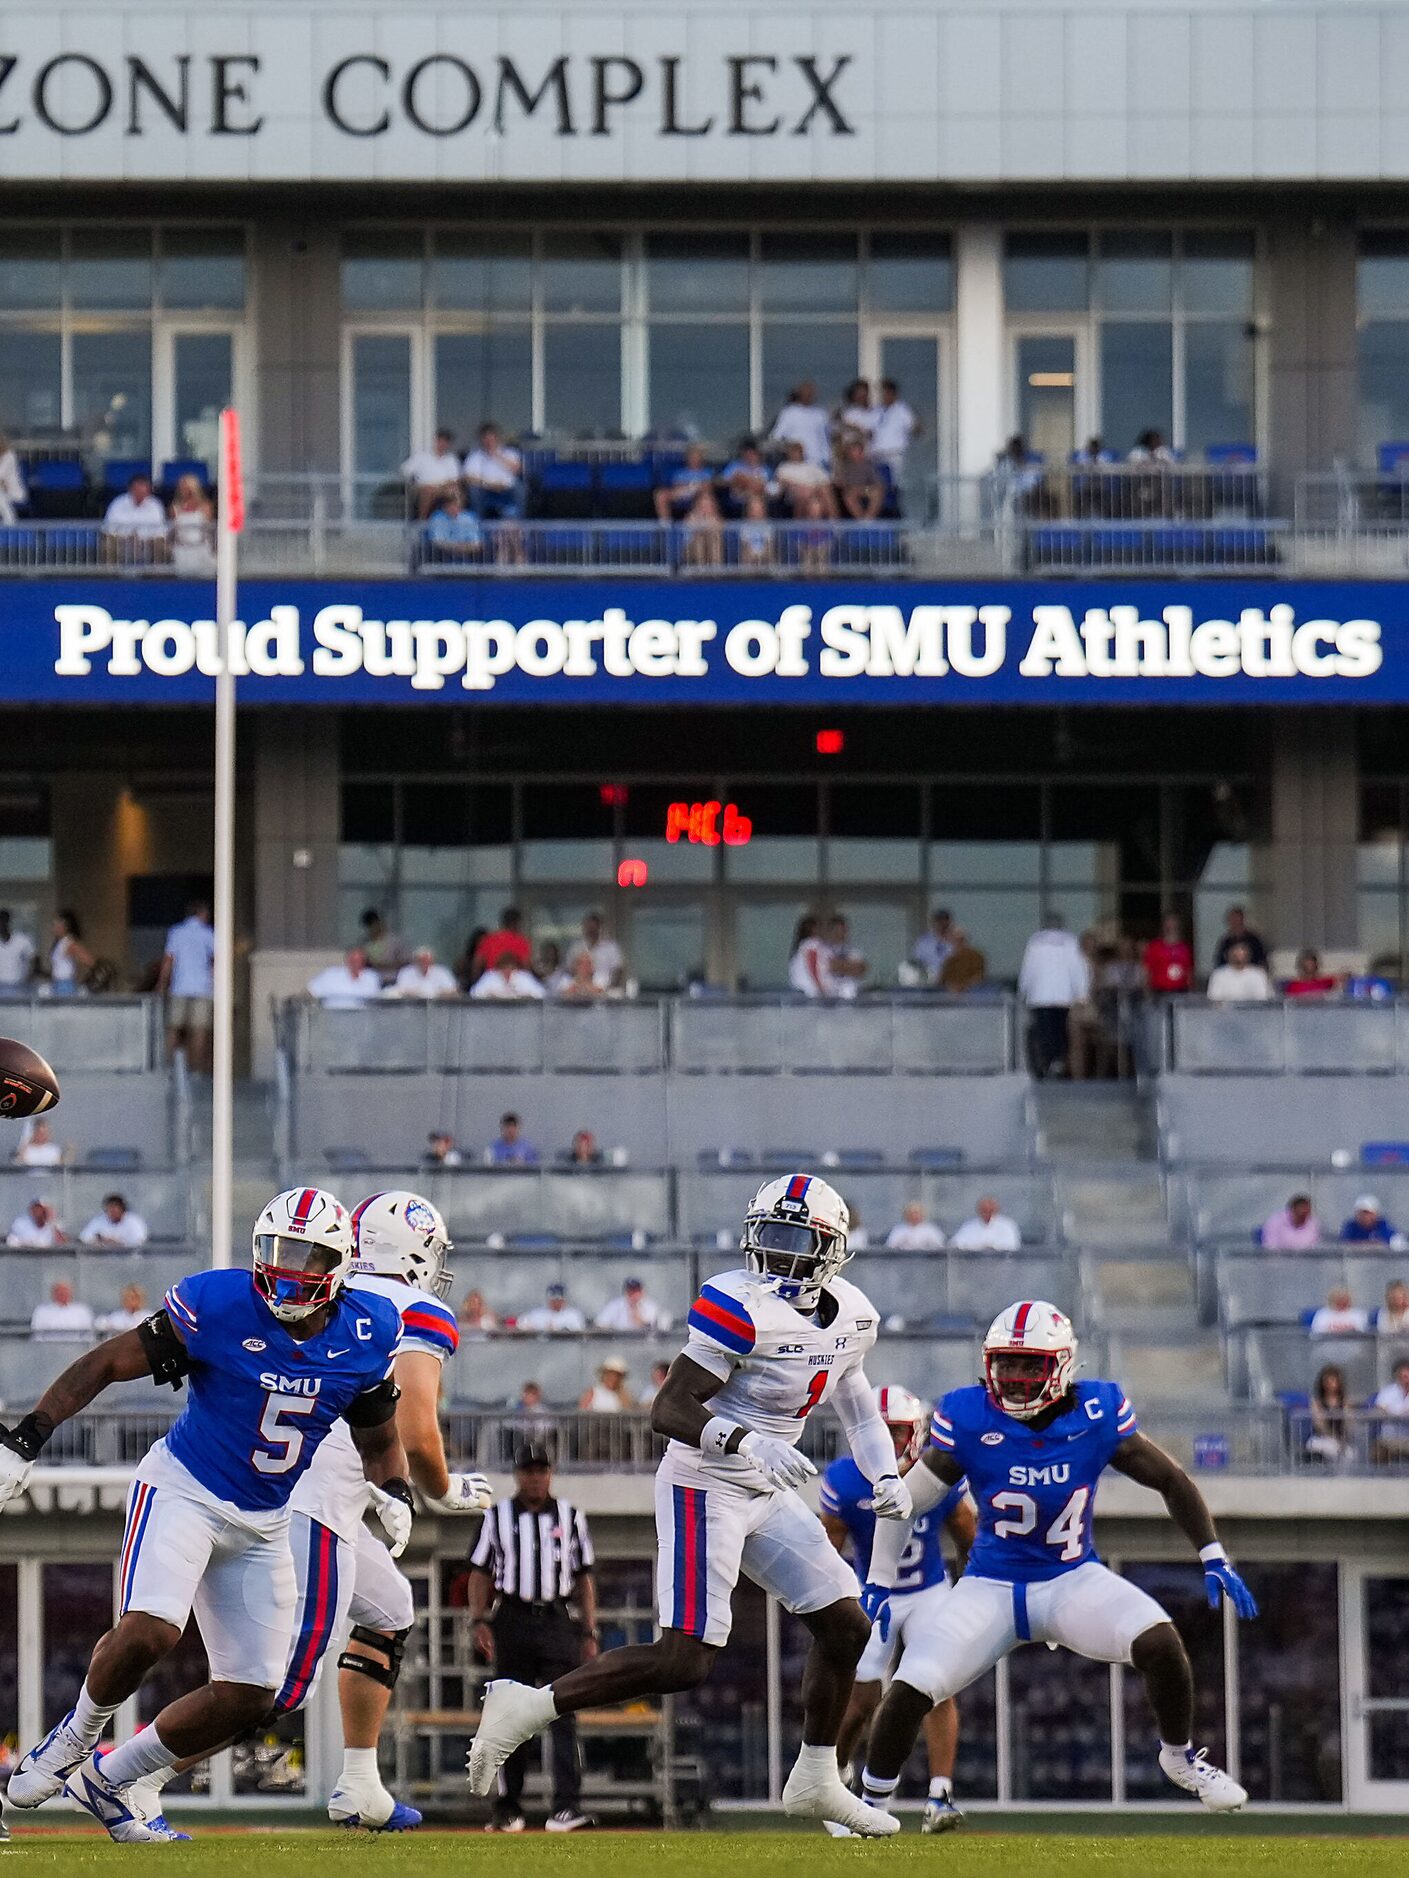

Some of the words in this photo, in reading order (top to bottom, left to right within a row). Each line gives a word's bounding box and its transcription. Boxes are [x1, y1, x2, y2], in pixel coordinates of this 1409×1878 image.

[324, 55, 854, 136] COMPLEX
[55, 606, 304, 676] Proud
[312, 605, 717, 689] Supporter
[724, 605, 811, 676] of
[819, 606, 1011, 676] SMU
[1019, 604, 1382, 677] Athletics
[355, 1318, 372, 1341] C
[808, 1355, 835, 1366] HUSKIES
[259, 1373, 322, 1396] SMU
[793, 1370, 829, 1418] 1
[1084, 1398, 1104, 1420] C
[251, 1392, 316, 1474] 5
[1009, 1464, 1070, 1486] SMU
[991, 1486, 1089, 1562] 24
